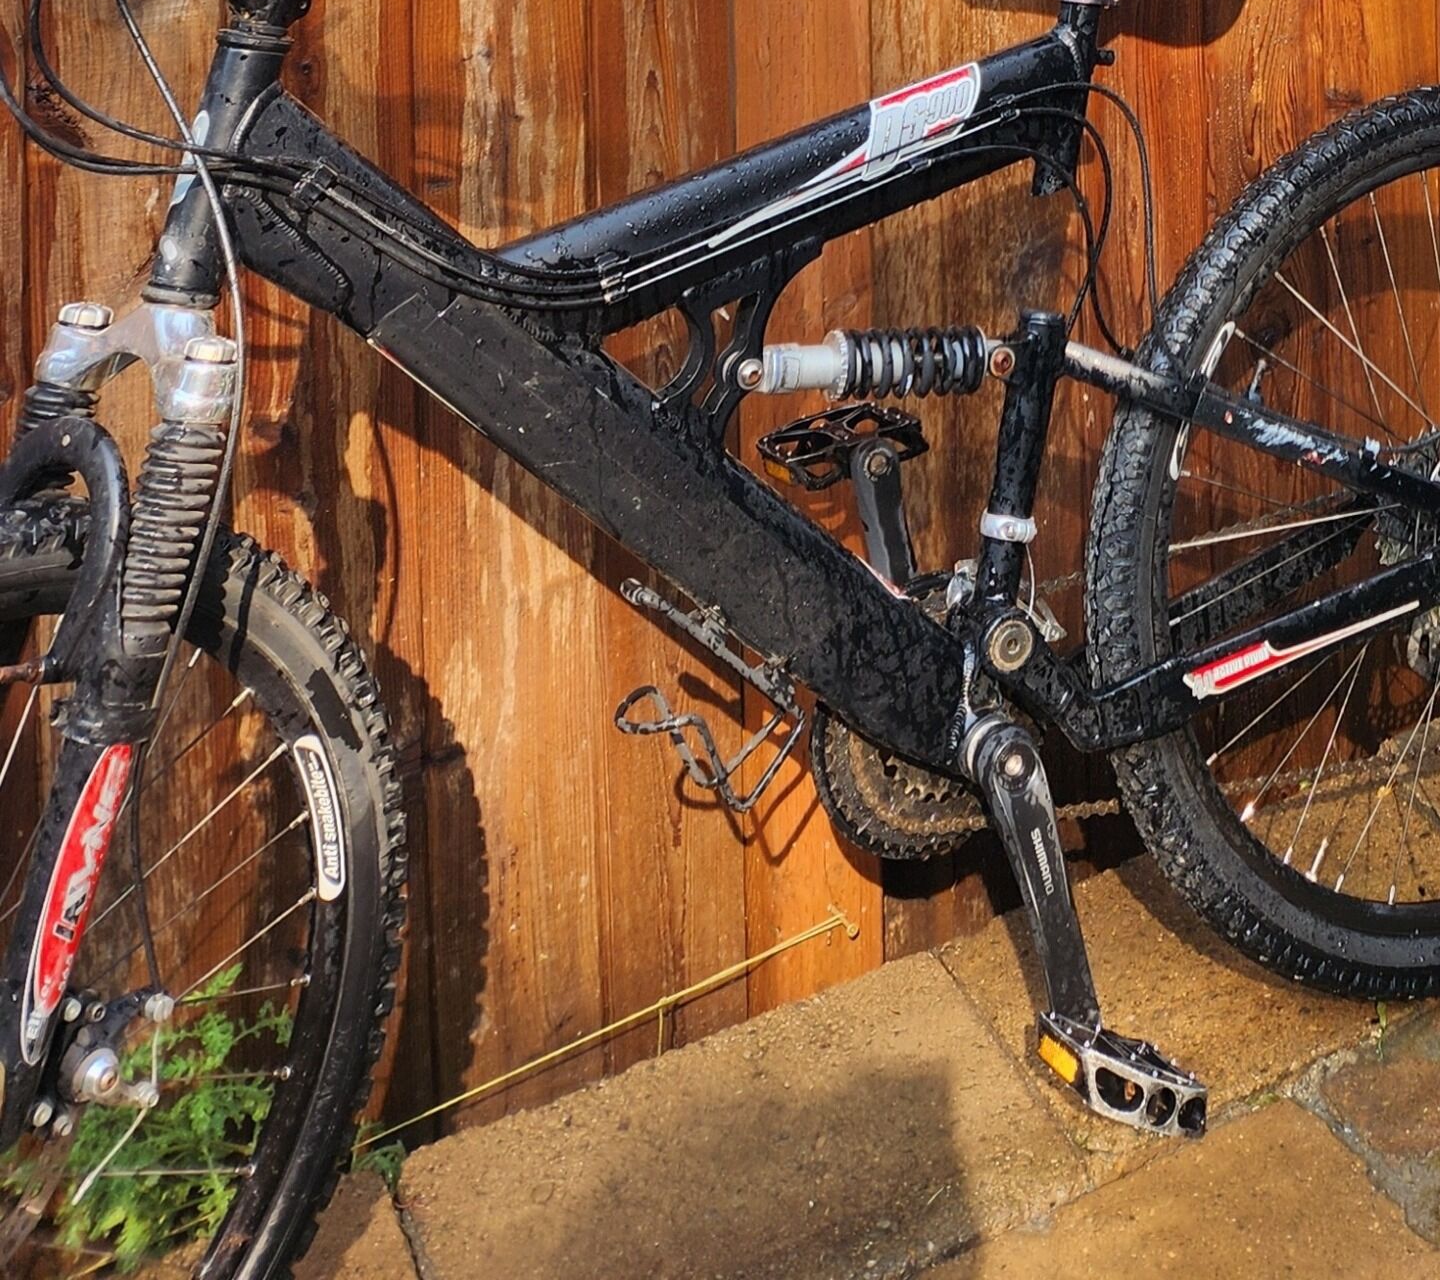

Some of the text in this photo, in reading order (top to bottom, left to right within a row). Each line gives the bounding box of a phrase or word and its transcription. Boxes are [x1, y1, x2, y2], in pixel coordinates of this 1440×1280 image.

[310, 770, 337, 842] snakebite
[324, 842, 340, 880] Anti
[1030, 827, 1055, 897] SHIMANO
